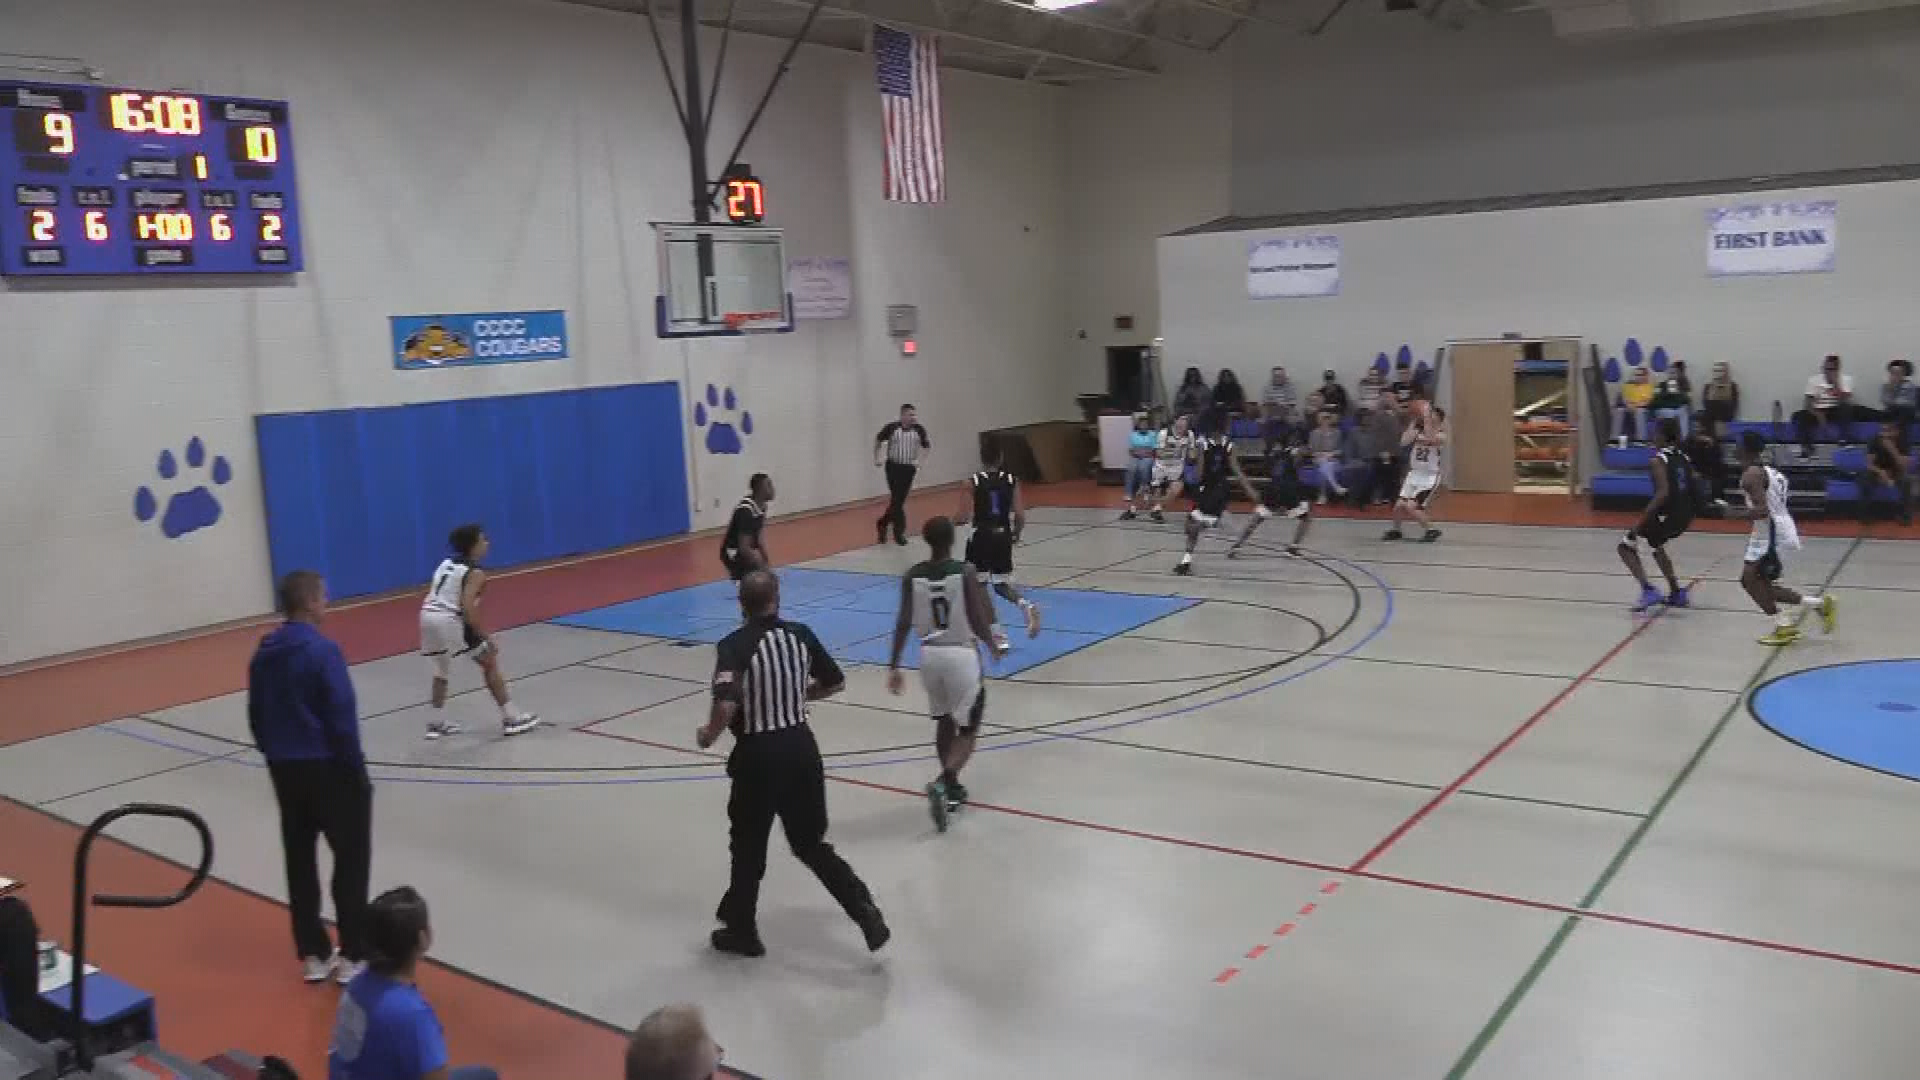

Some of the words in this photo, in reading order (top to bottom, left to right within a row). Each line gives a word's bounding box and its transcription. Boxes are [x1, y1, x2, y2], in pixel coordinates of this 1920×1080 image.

[109, 92, 201, 135] 16:08
[43, 112, 75, 153] 9
[245, 126, 278, 163] 10
[194, 155, 208, 179] 1
[727, 181, 763, 217] 27
[31, 210, 55, 241] 2
[84, 211, 109, 241] 6
[210, 213, 232, 241] 6
[262, 215, 282, 241] 2
[1713, 231, 1769, 250] FIRST
[1772, 229, 1827, 247] BANK
[473, 319, 526, 337] CCCC
[474, 336, 562, 357] COUGARS
[931, 596, 950, 631] 0
